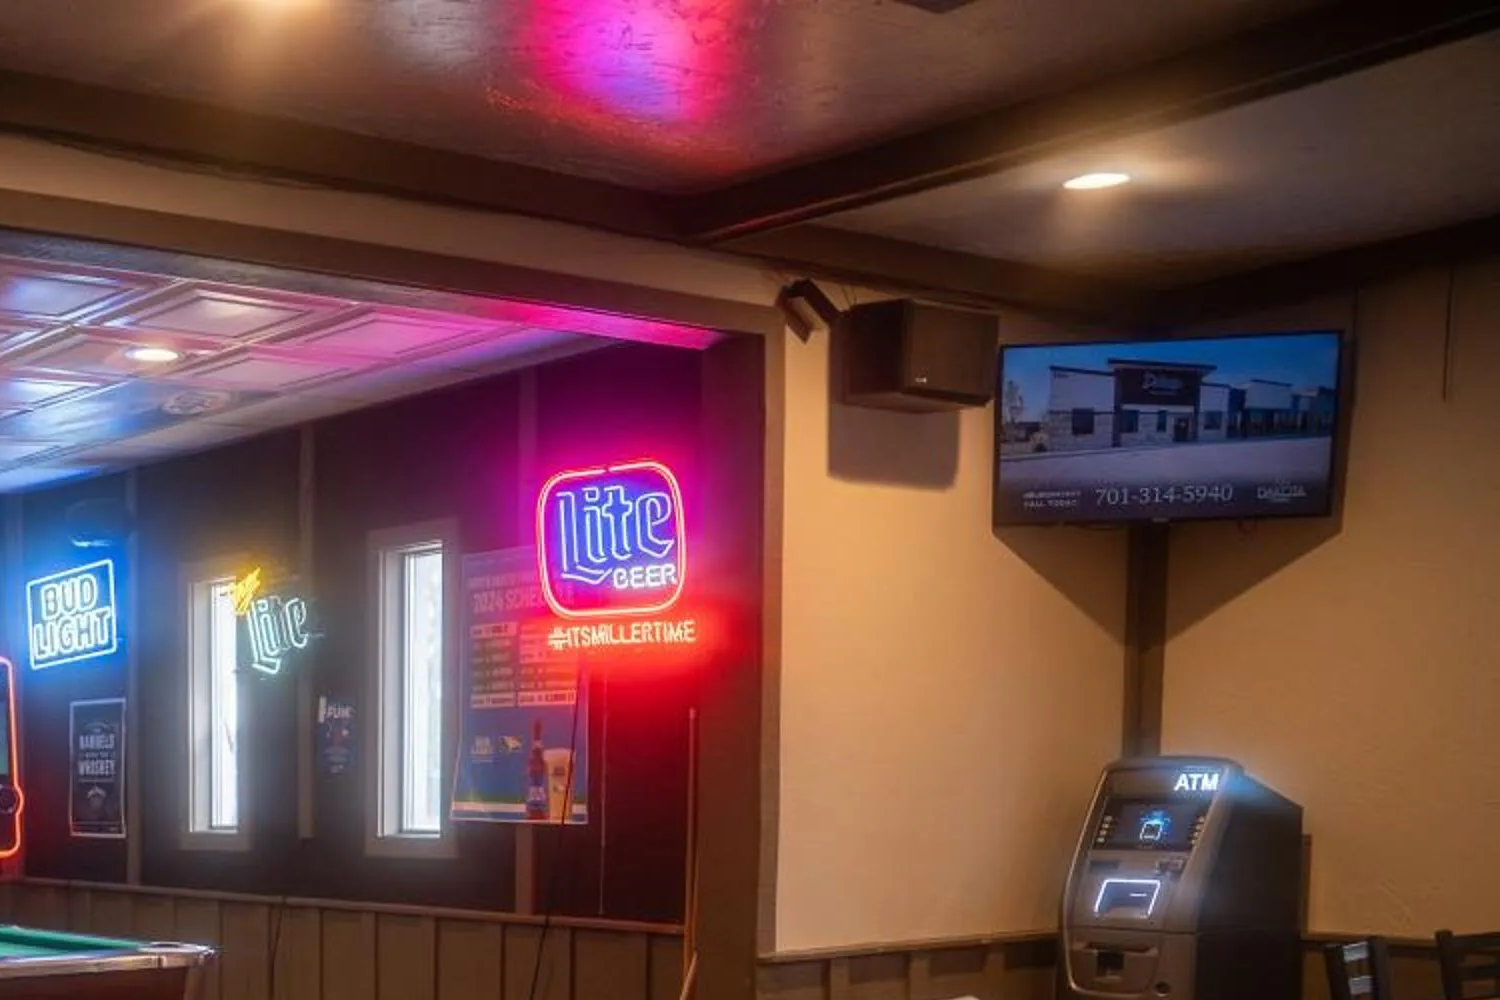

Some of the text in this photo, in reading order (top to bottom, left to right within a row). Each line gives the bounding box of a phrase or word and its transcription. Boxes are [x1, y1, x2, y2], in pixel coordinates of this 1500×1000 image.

[1095, 485, 1234, 506] 701-314-5940
[556, 484, 675, 585] Lite
[612, 563, 678, 590] BEER
[40, 573, 98, 621] BUD
[32, 606, 111, 661] LIGHT
[247, 595, 309, 675] Lite
[547, 618, 697, 651] #ITSMILLERTIME
[1173, 772, 1220, 792] ATM
